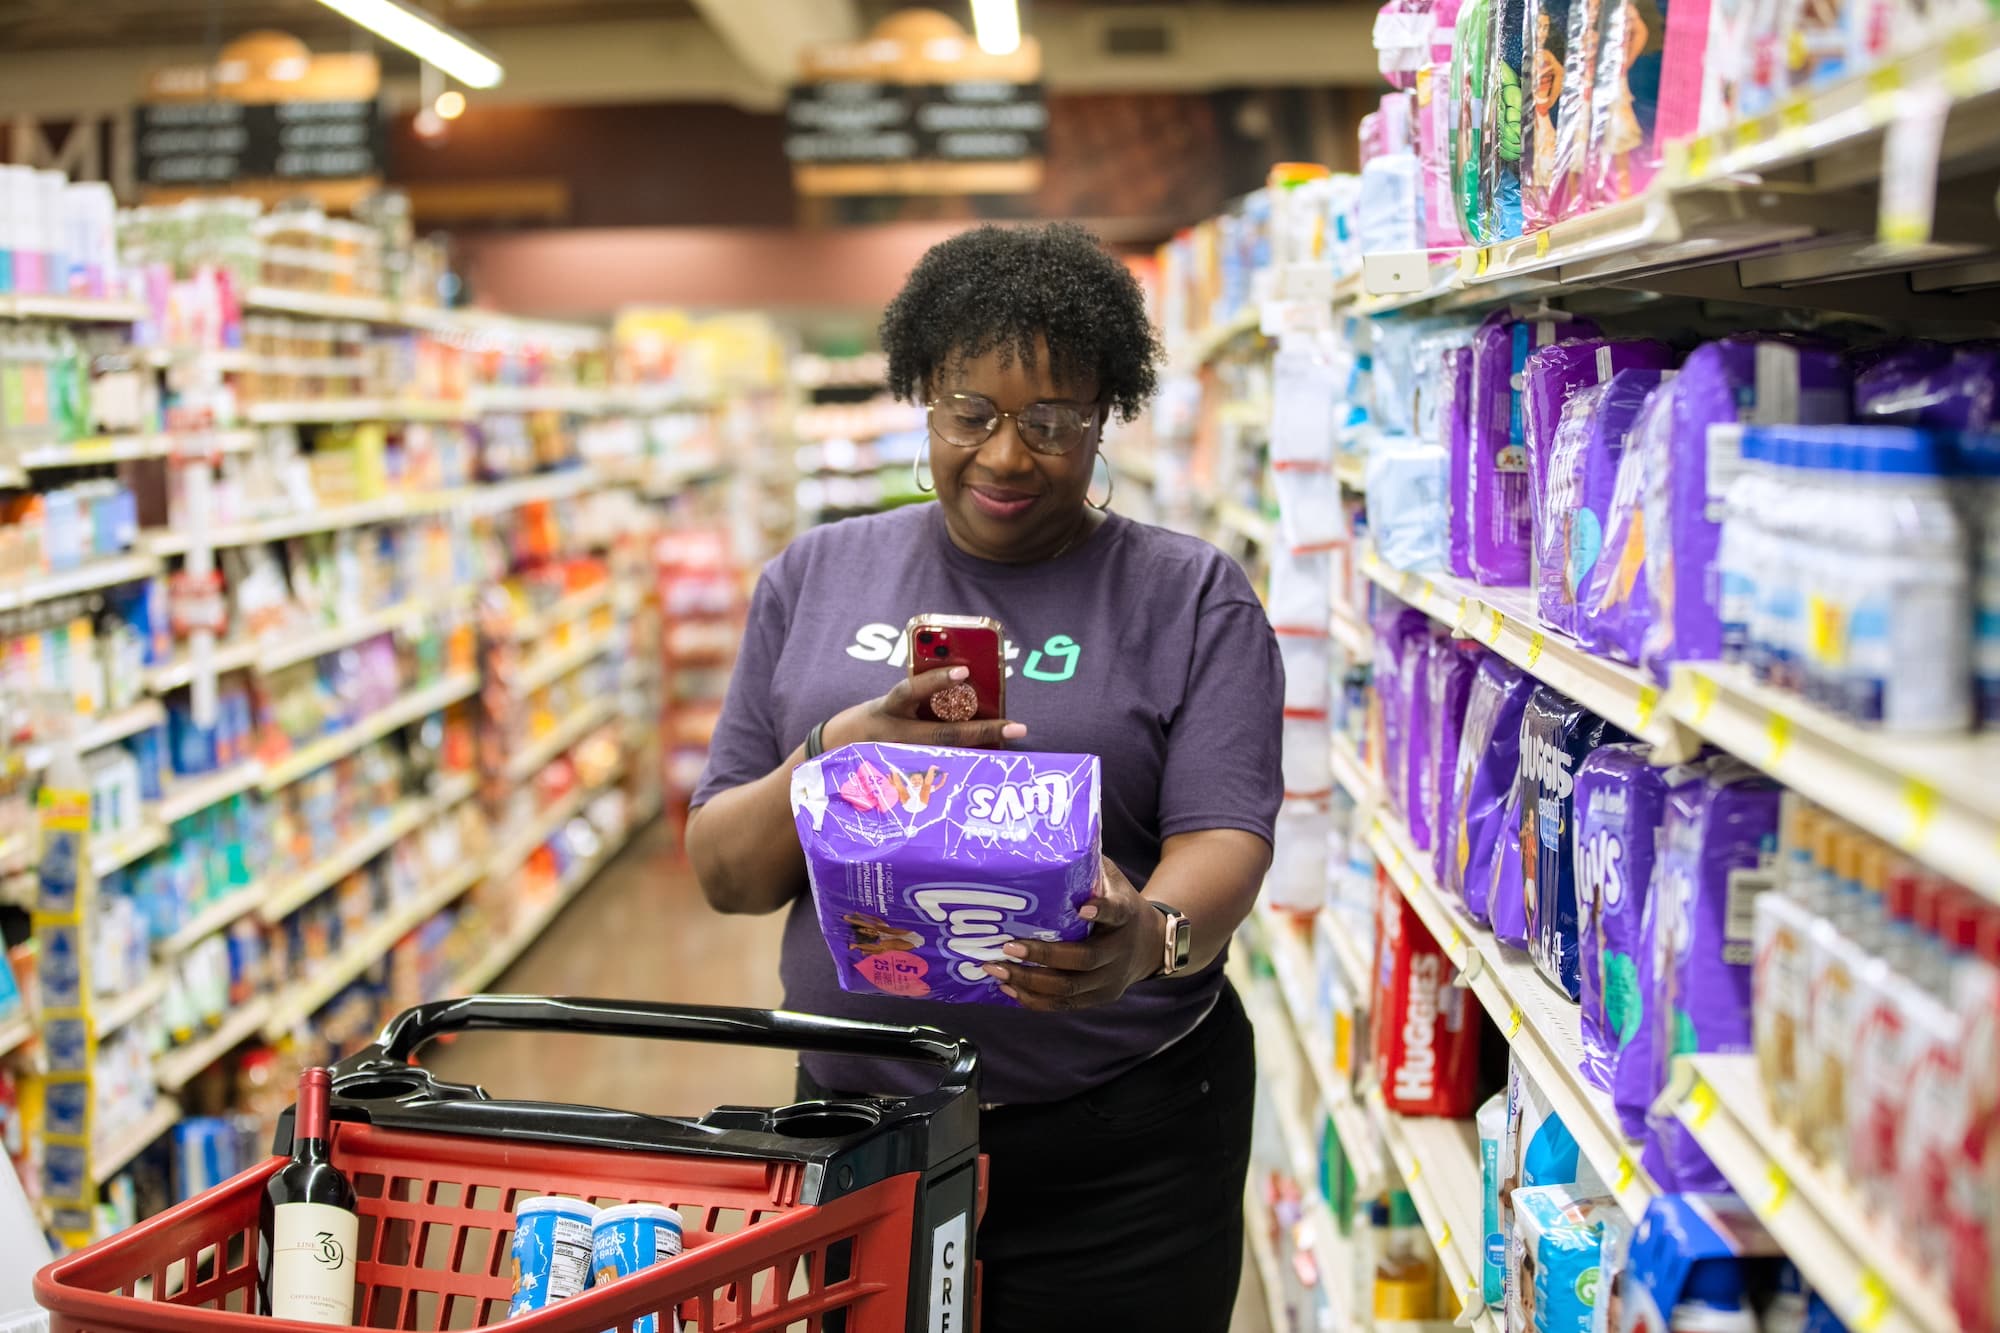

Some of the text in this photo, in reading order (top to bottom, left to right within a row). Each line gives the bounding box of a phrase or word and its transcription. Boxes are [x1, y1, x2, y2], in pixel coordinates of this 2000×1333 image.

[874, 959, 889, 971] 25
[896, 963, 918, 975] 5
[1394, 952, 1440, 1101] HUGGIES
[580, 1224, 592, 1232] Fact
[313, 1231, 344, 1270] 39
